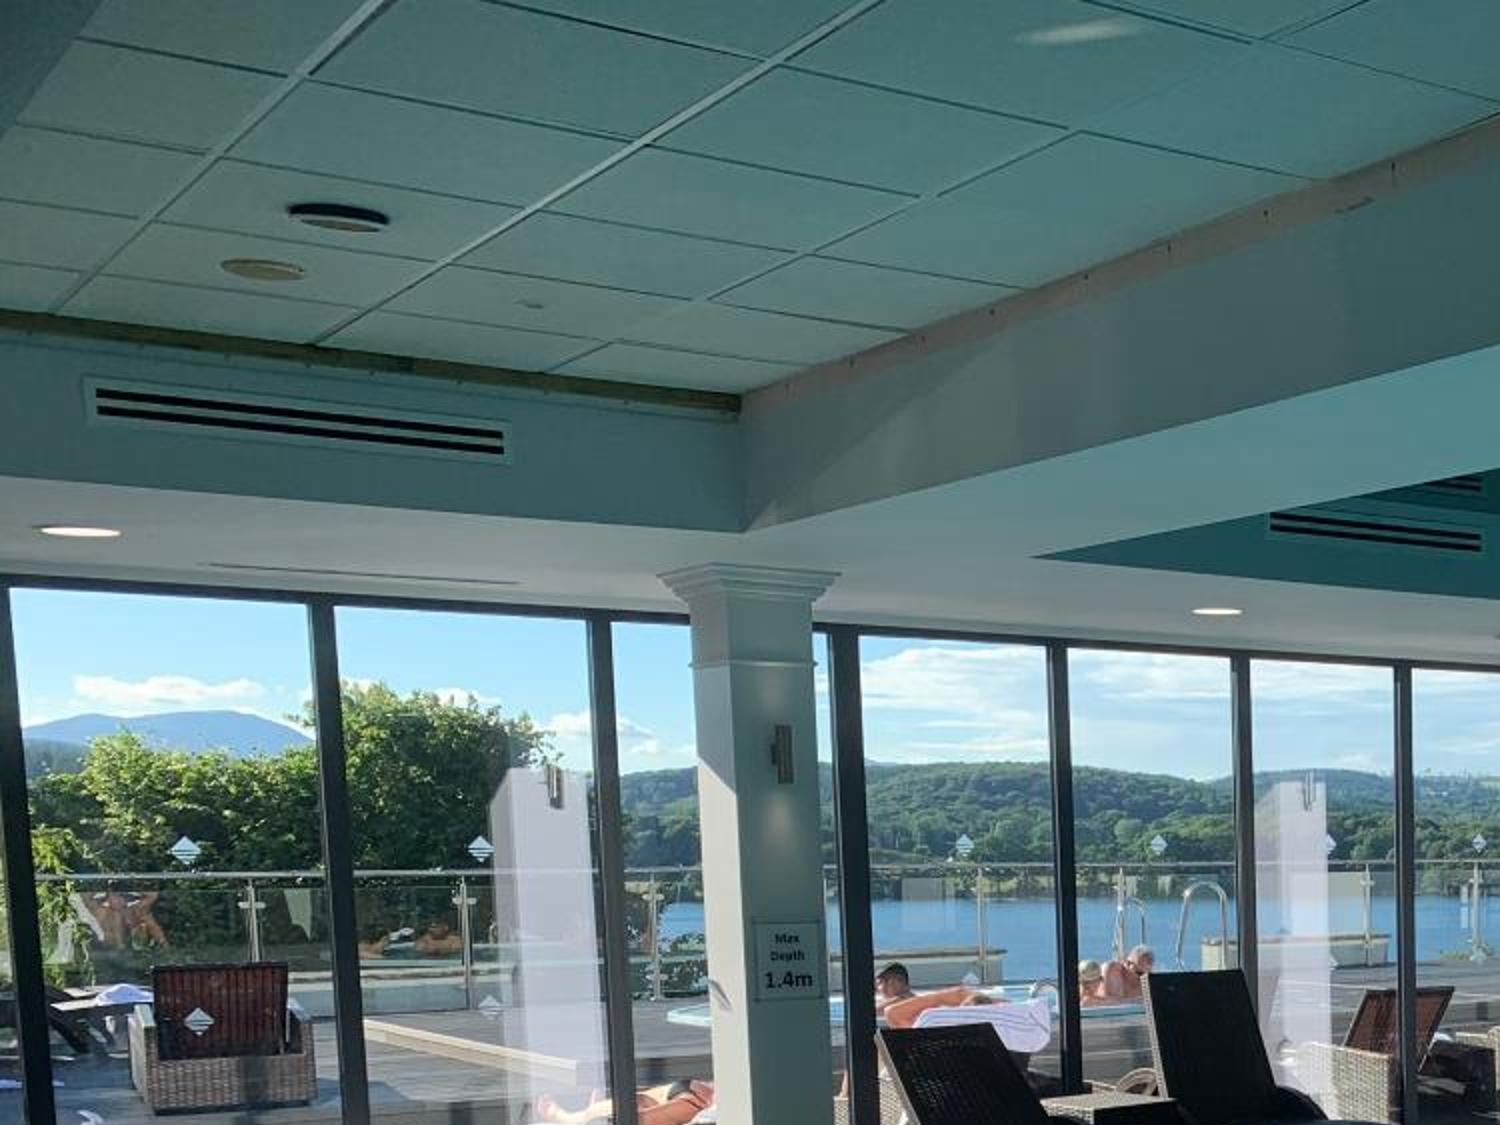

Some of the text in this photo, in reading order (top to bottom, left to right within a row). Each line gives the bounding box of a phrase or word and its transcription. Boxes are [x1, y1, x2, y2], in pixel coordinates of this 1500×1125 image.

[774, 933, 800, 945] Max
[770, 949, 806, 962] Depth
[765, 971, 813, 989] 1.4m
